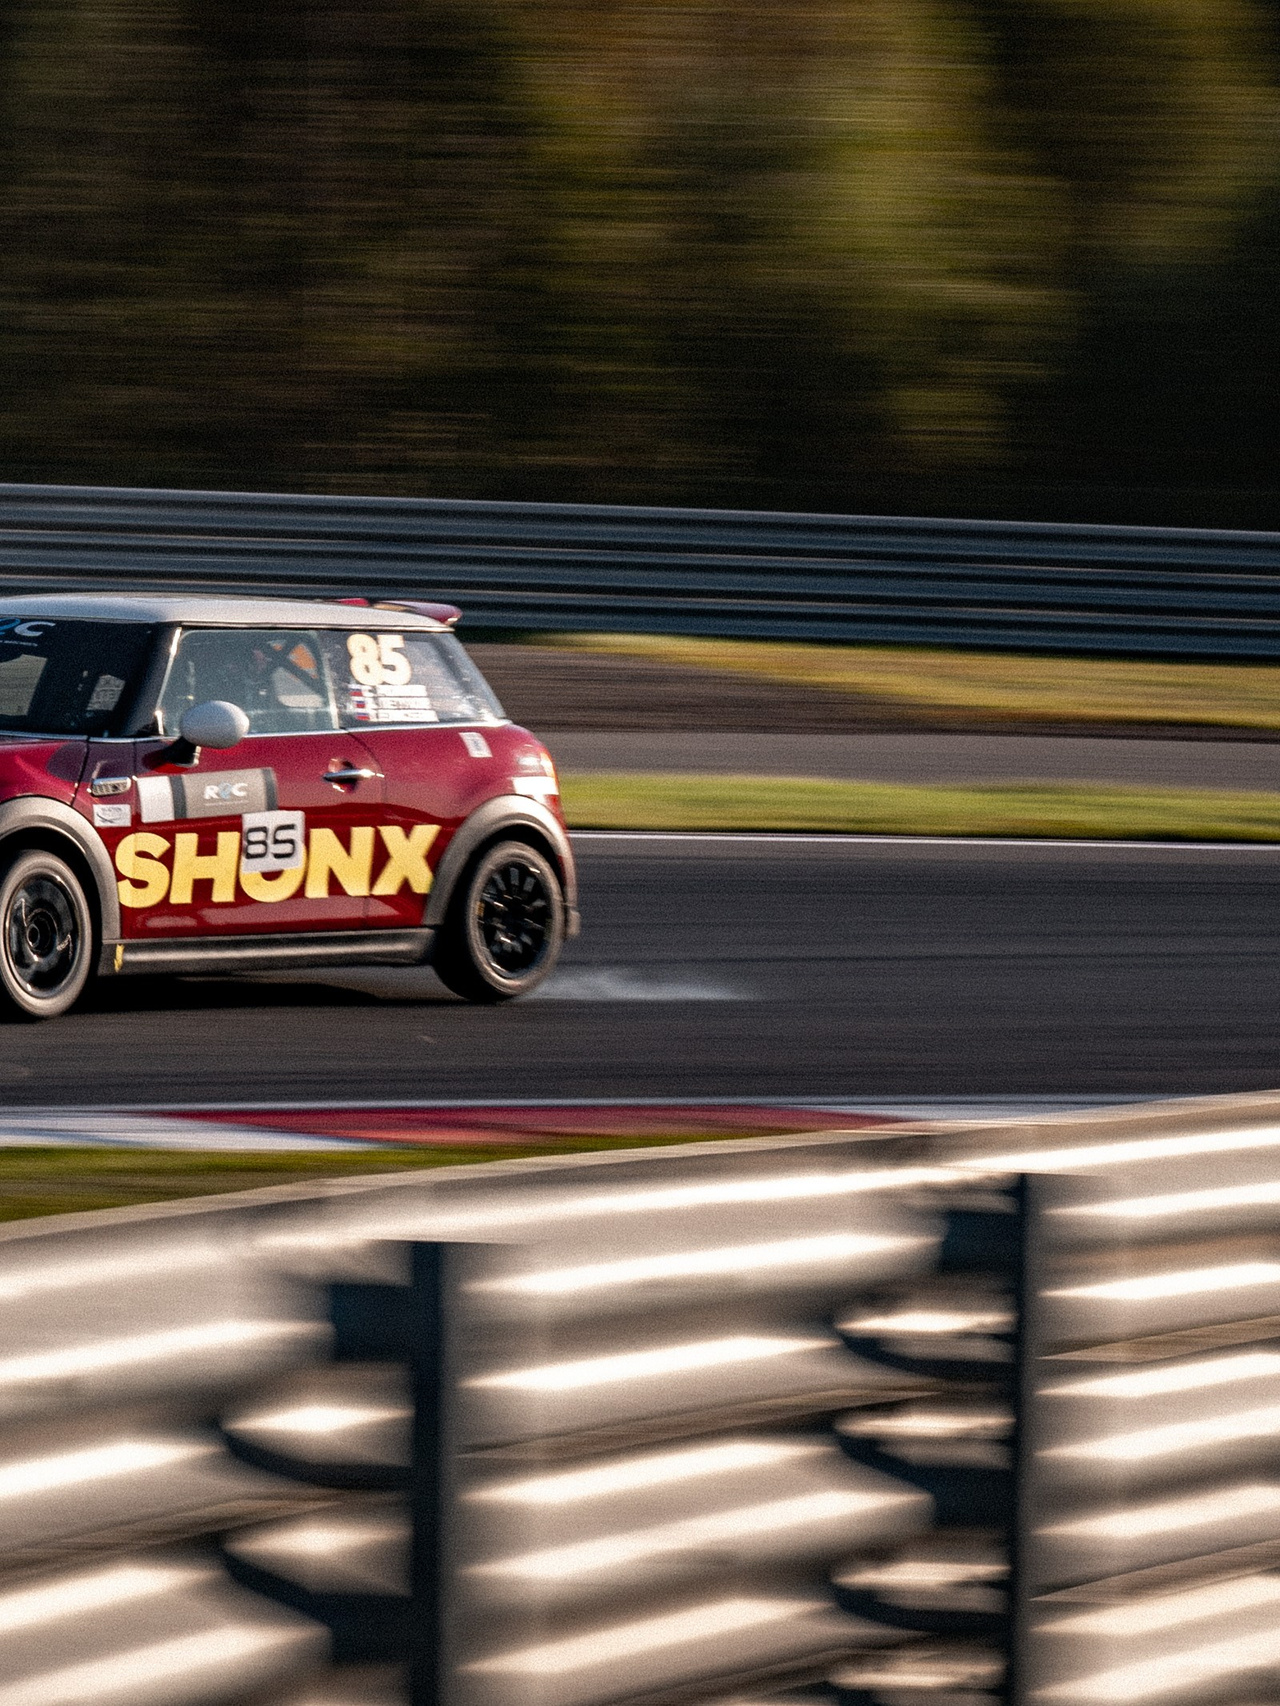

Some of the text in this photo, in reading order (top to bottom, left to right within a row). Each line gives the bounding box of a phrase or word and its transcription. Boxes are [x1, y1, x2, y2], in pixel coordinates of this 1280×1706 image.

[346, 633, 412, 686] 85
[115, 824, 442, 908] SHONX
[243, 823, 297, 860] 85
